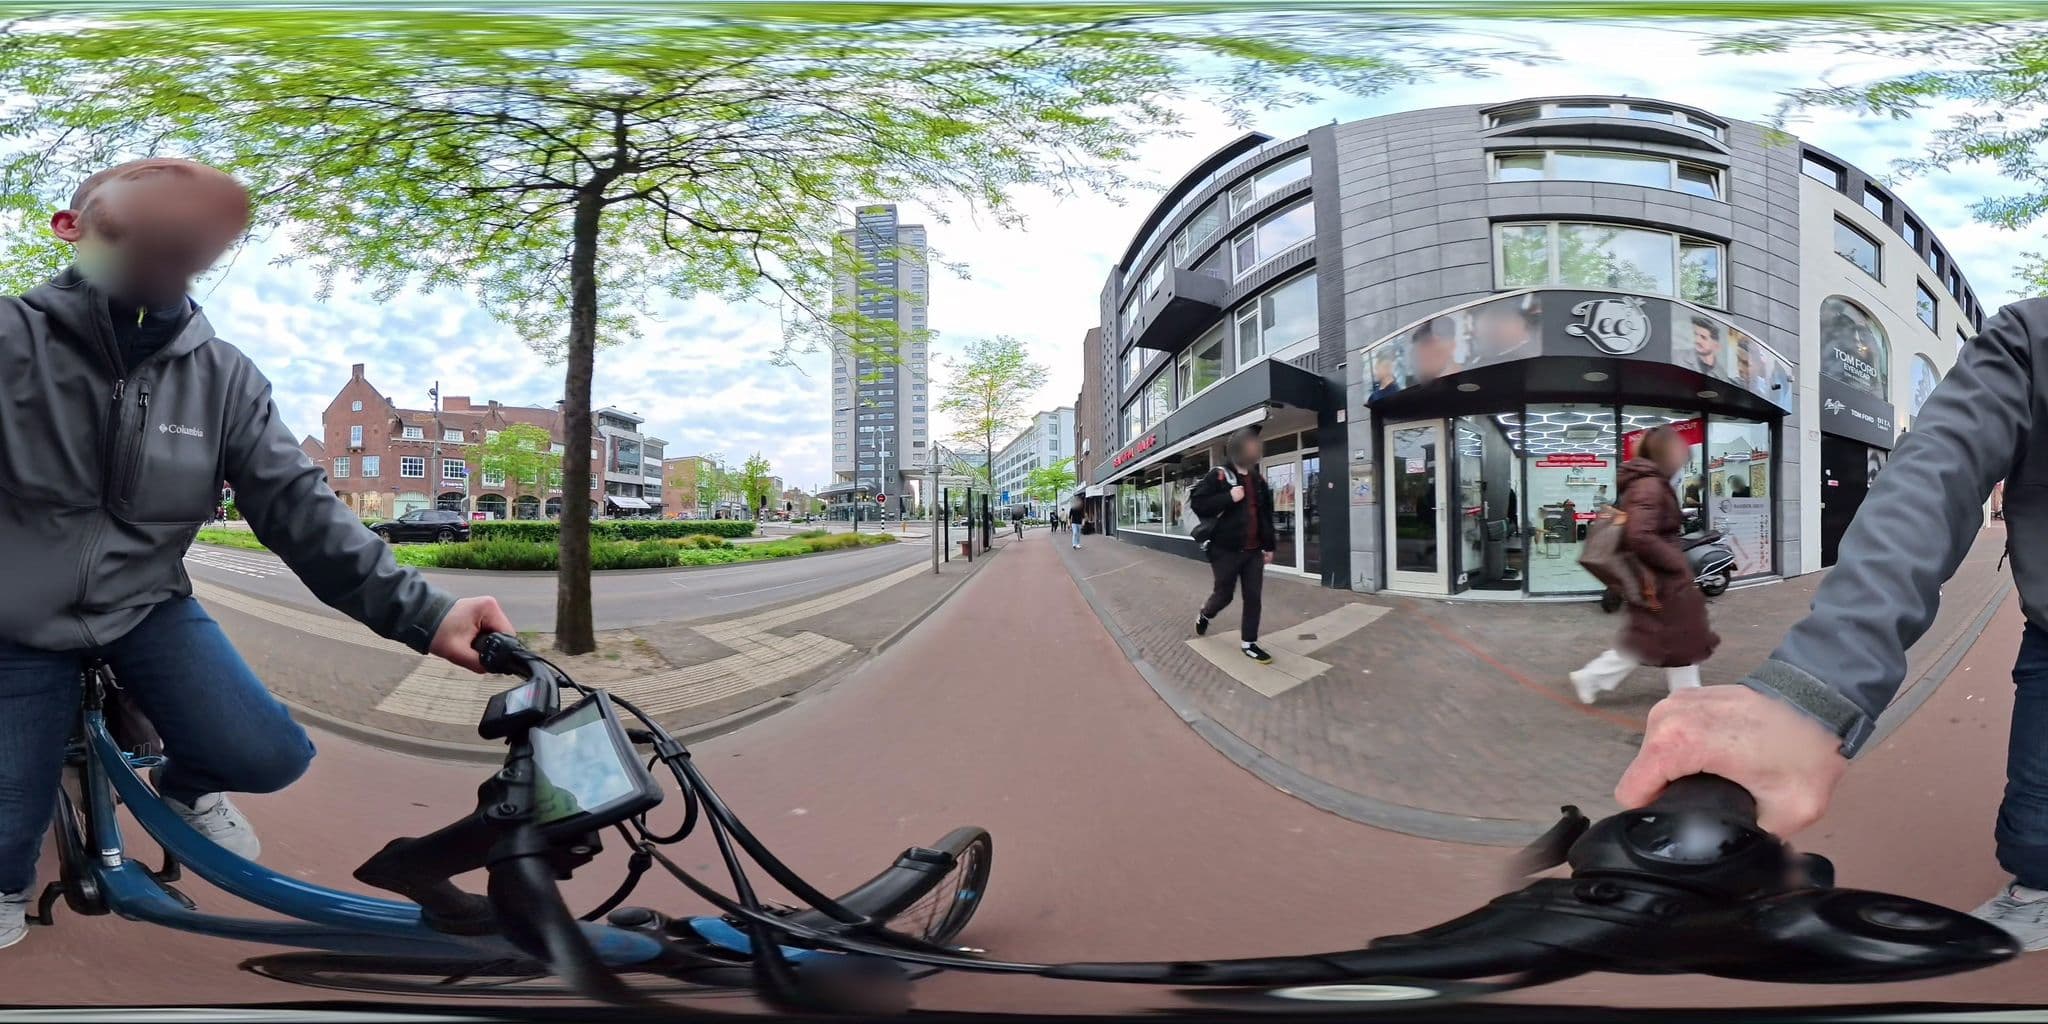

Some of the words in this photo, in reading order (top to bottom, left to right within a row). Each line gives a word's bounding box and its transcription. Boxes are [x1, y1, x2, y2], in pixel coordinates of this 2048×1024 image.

[1833, 347, 1855, 366] TOM
[1855, 358, 1877, 377] FORD
[1843, 362, 1871, 381] EYEWEAR
[1851, 408, 1862, 419] TOM
[1861, 413, 1875, 423] FORD
[168, 424, 204, 437] Columbia
